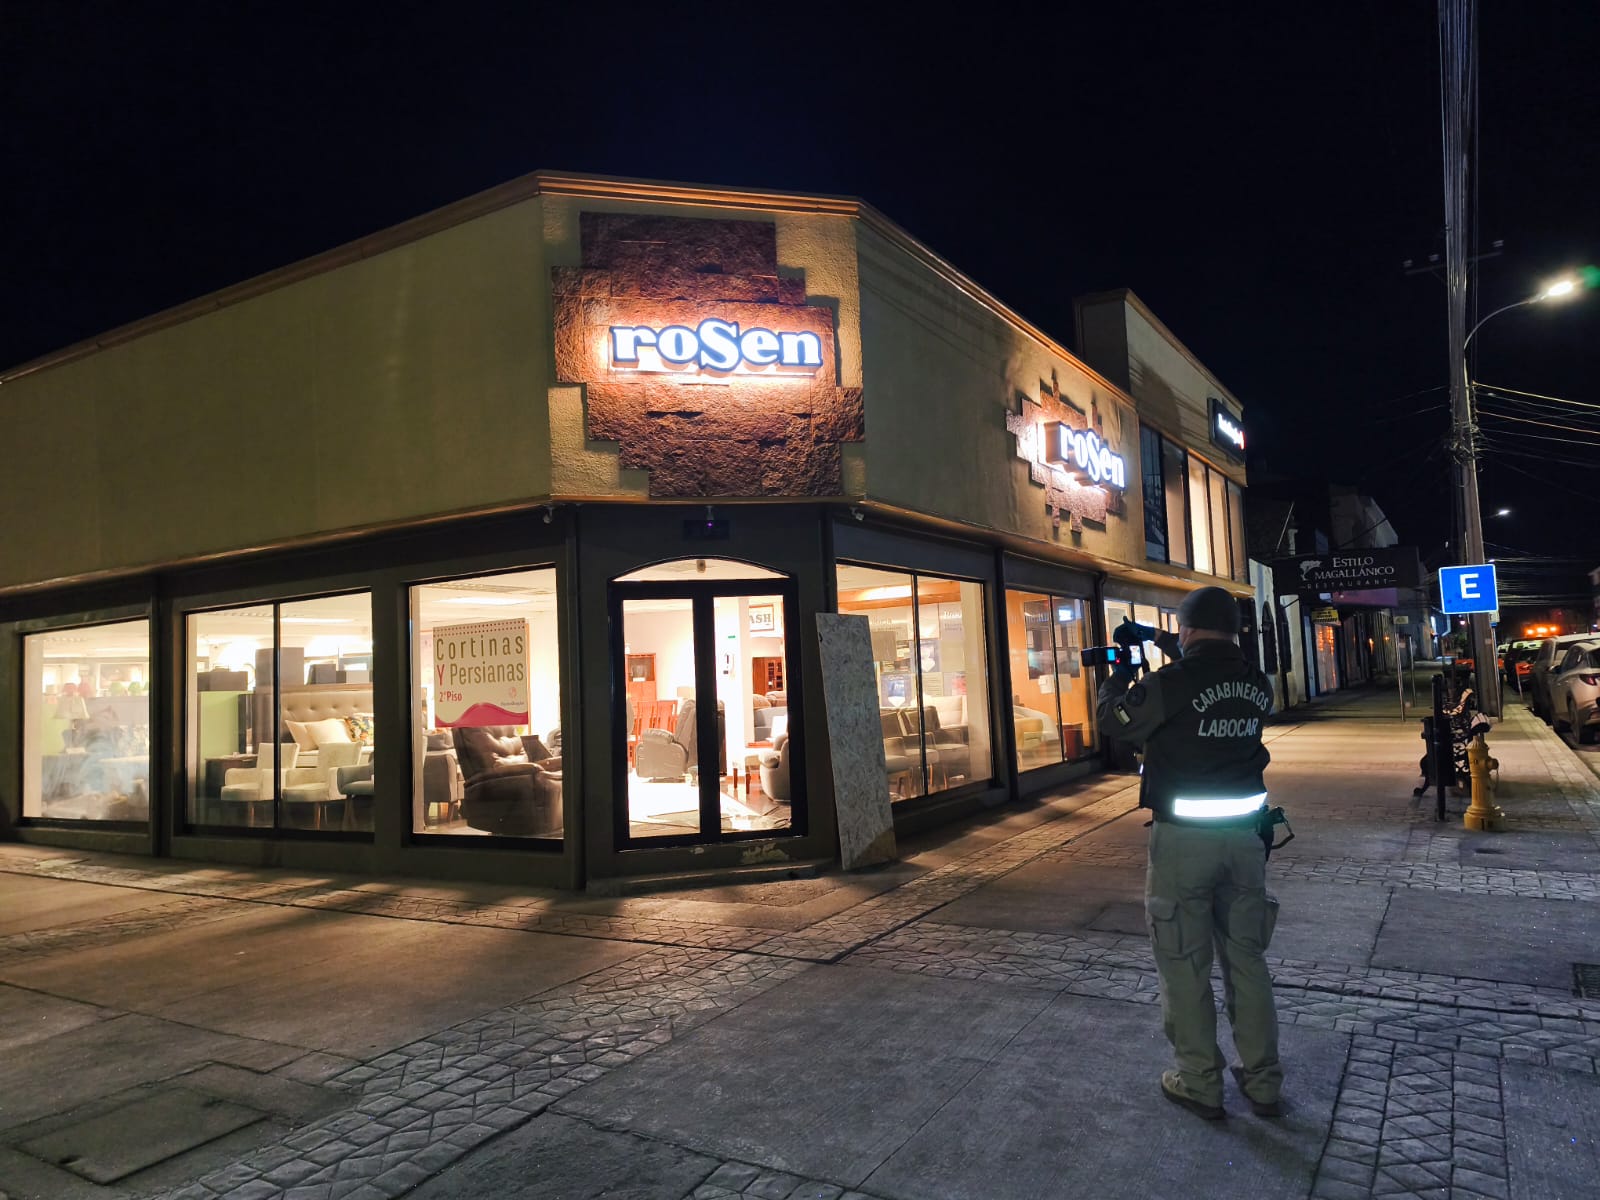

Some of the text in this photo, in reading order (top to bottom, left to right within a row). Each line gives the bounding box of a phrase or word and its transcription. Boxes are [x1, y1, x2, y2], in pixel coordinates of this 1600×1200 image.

[1460, 573, 1480, 599] E
[436, 634, 524, 661] Cortinas
[437, 660, 524, 686] Y Persianas
[1192, 681, 1269, 713] CARABINEROS
[1198, 717, 1259, 738] LABOCAR
